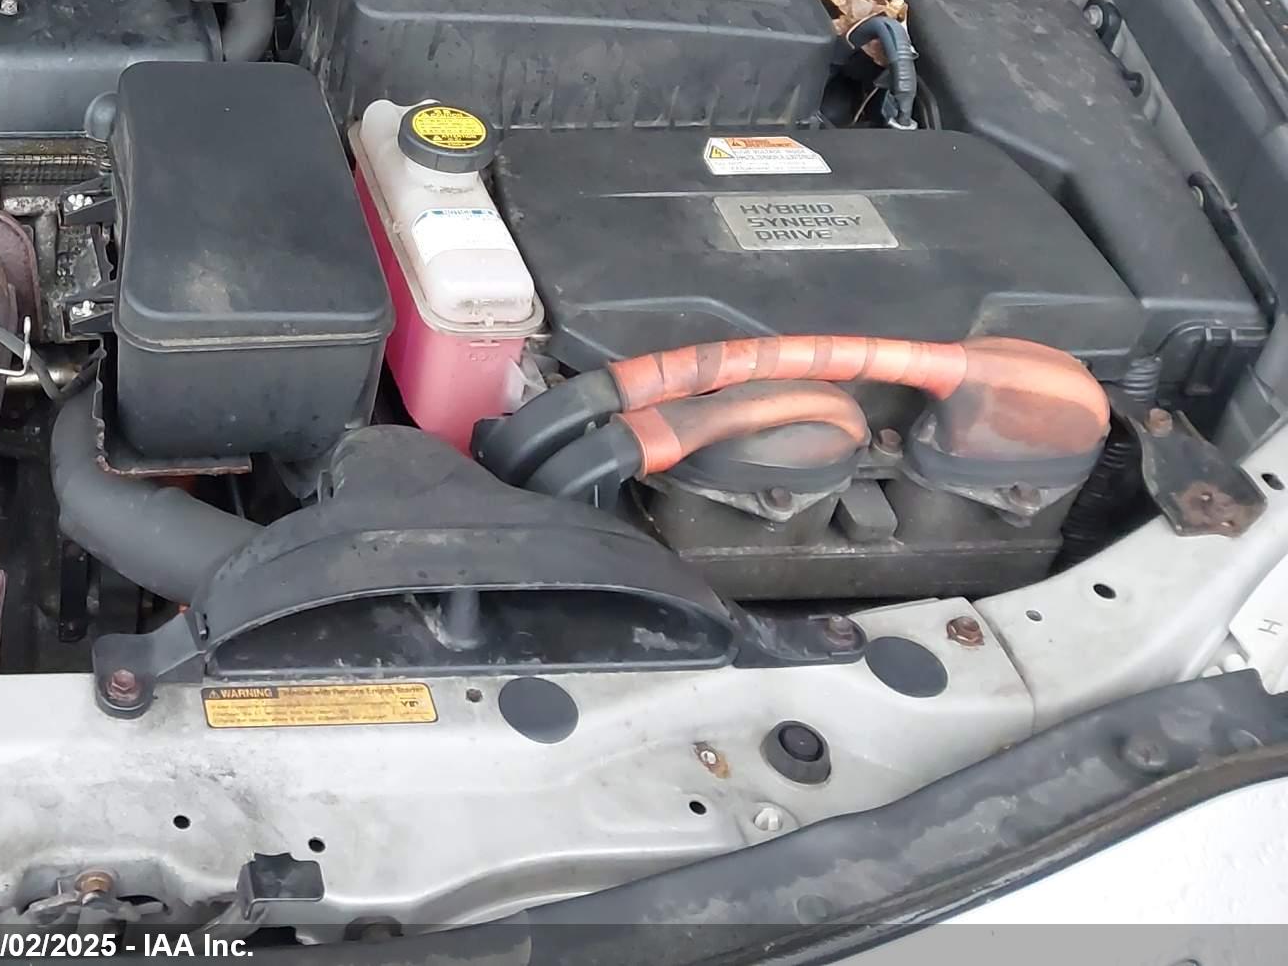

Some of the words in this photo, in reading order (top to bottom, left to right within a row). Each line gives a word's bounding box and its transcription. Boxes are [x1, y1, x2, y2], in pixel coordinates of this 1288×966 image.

[739, 203, 835, 215] HYBRID
[747, 216, 862, 228] SYNERGY
[755, 230, 833, 241] DRIVE
[220, 688, 273, 699] WARNING
